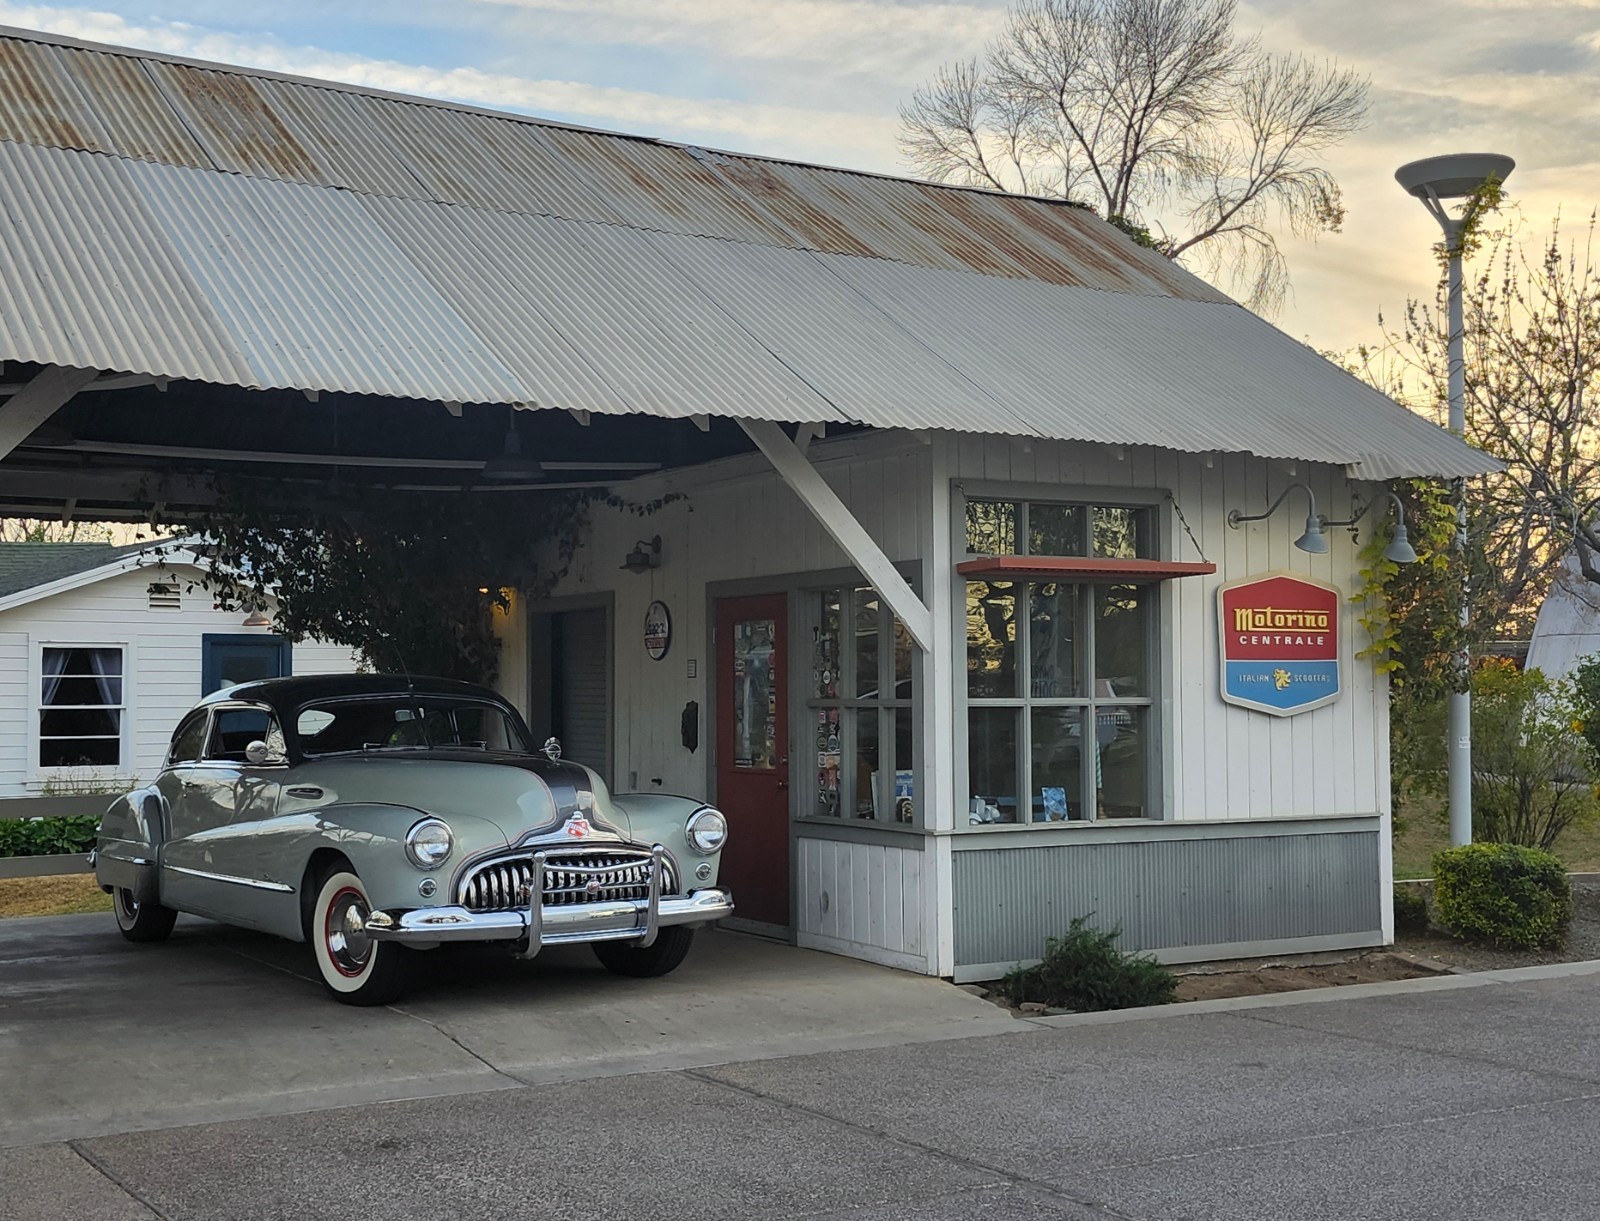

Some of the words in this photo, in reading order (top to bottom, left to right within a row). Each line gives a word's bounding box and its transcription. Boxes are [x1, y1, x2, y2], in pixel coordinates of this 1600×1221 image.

[1234, 606, 1329, 632] Motorino
[1239, 635, 1325, 646] CENTRALE
[1239, 674, 1269, 683] ITALIAN
